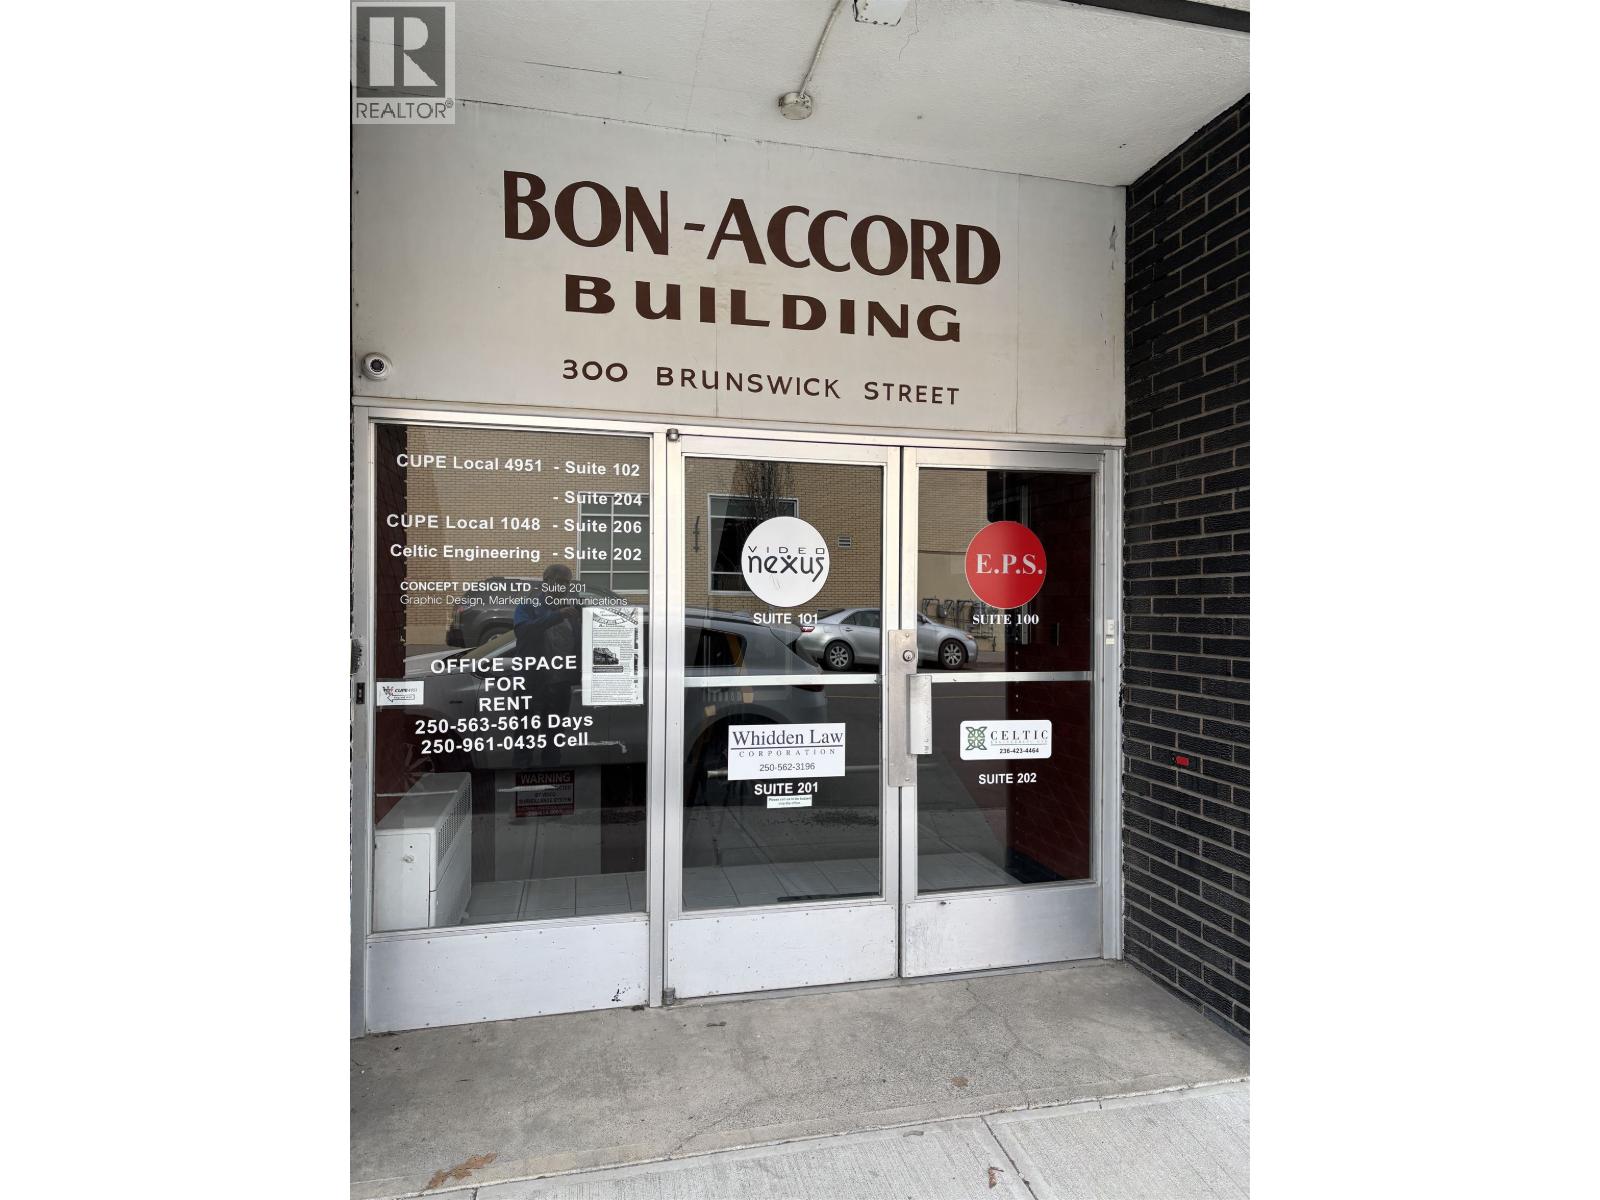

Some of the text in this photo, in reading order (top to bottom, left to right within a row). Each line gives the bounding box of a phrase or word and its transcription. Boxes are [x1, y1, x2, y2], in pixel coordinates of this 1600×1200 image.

[564, 273, 961, 343] BUILDING
[562, 359, 960, 405] 300 BRUNSWICK STREET
[396, 453, 447, 469] CUPE
[453, 456, 499, 471] Local
[504, 458, 542, 472] 4951
[565, 461, 607, 475] Suite
[613, 463, 640, 477] 102
[564, 491, 608, 505] Suite
[613, 493, 642, 507] 204
[386, 513, 438, 529] CUPE
[446, 516, 494, 530] Local
[500, 517, 540, 531] 1048
[564, 518, 607, 533] Suite
[613, 521, 642, 534] 206
[390, 543, 437, 558] Celtic
[443, 545, 541, 562] Engineering
[564, 546, 607, 560] Suite
[613, 548, 642, 561] 202
[748, 545, 825, 554] VIDEO
[748, 555, 825, 582] nexus
[976, 553, 1043, 575] E.P.S.
[400, 581, 458, 592] CONCEPT
[462, 581, 507, 592] DESIGN
[510, 582, 531, 592] LTD
[541, 583, 566, 593] Suite
[569, 583, 586, 593] 201
[400, 595, 628, 608] Graphic Design, Marketing, Communications
[753, 612, 818, 625] SUITE 101
[972, 614, 1040, 625] SUITE 100
[430, 657, 504, 674] OFFICE
[511, 655, 577, 671] SPACE
[484, 676, 526, 692] FOR
[479, 695, 532, 712] RENT
[415, 713, 594, 735] 250-563-5616 Days
[421, 732, 588, 755] 250-961-0435 Cell
[732, 729, 844, 746] Whidden Law
[990, 730, 1048, 741] CELTIC
[739, 748, 836, 757] CORPORATION
[759, 762, 816, 772] 250-562-3196
[520, 772, 571, 784] WARNING
[978, 772, 1037, 785] SUITE 202
[754, 782, 818, 796] SUITE 201
